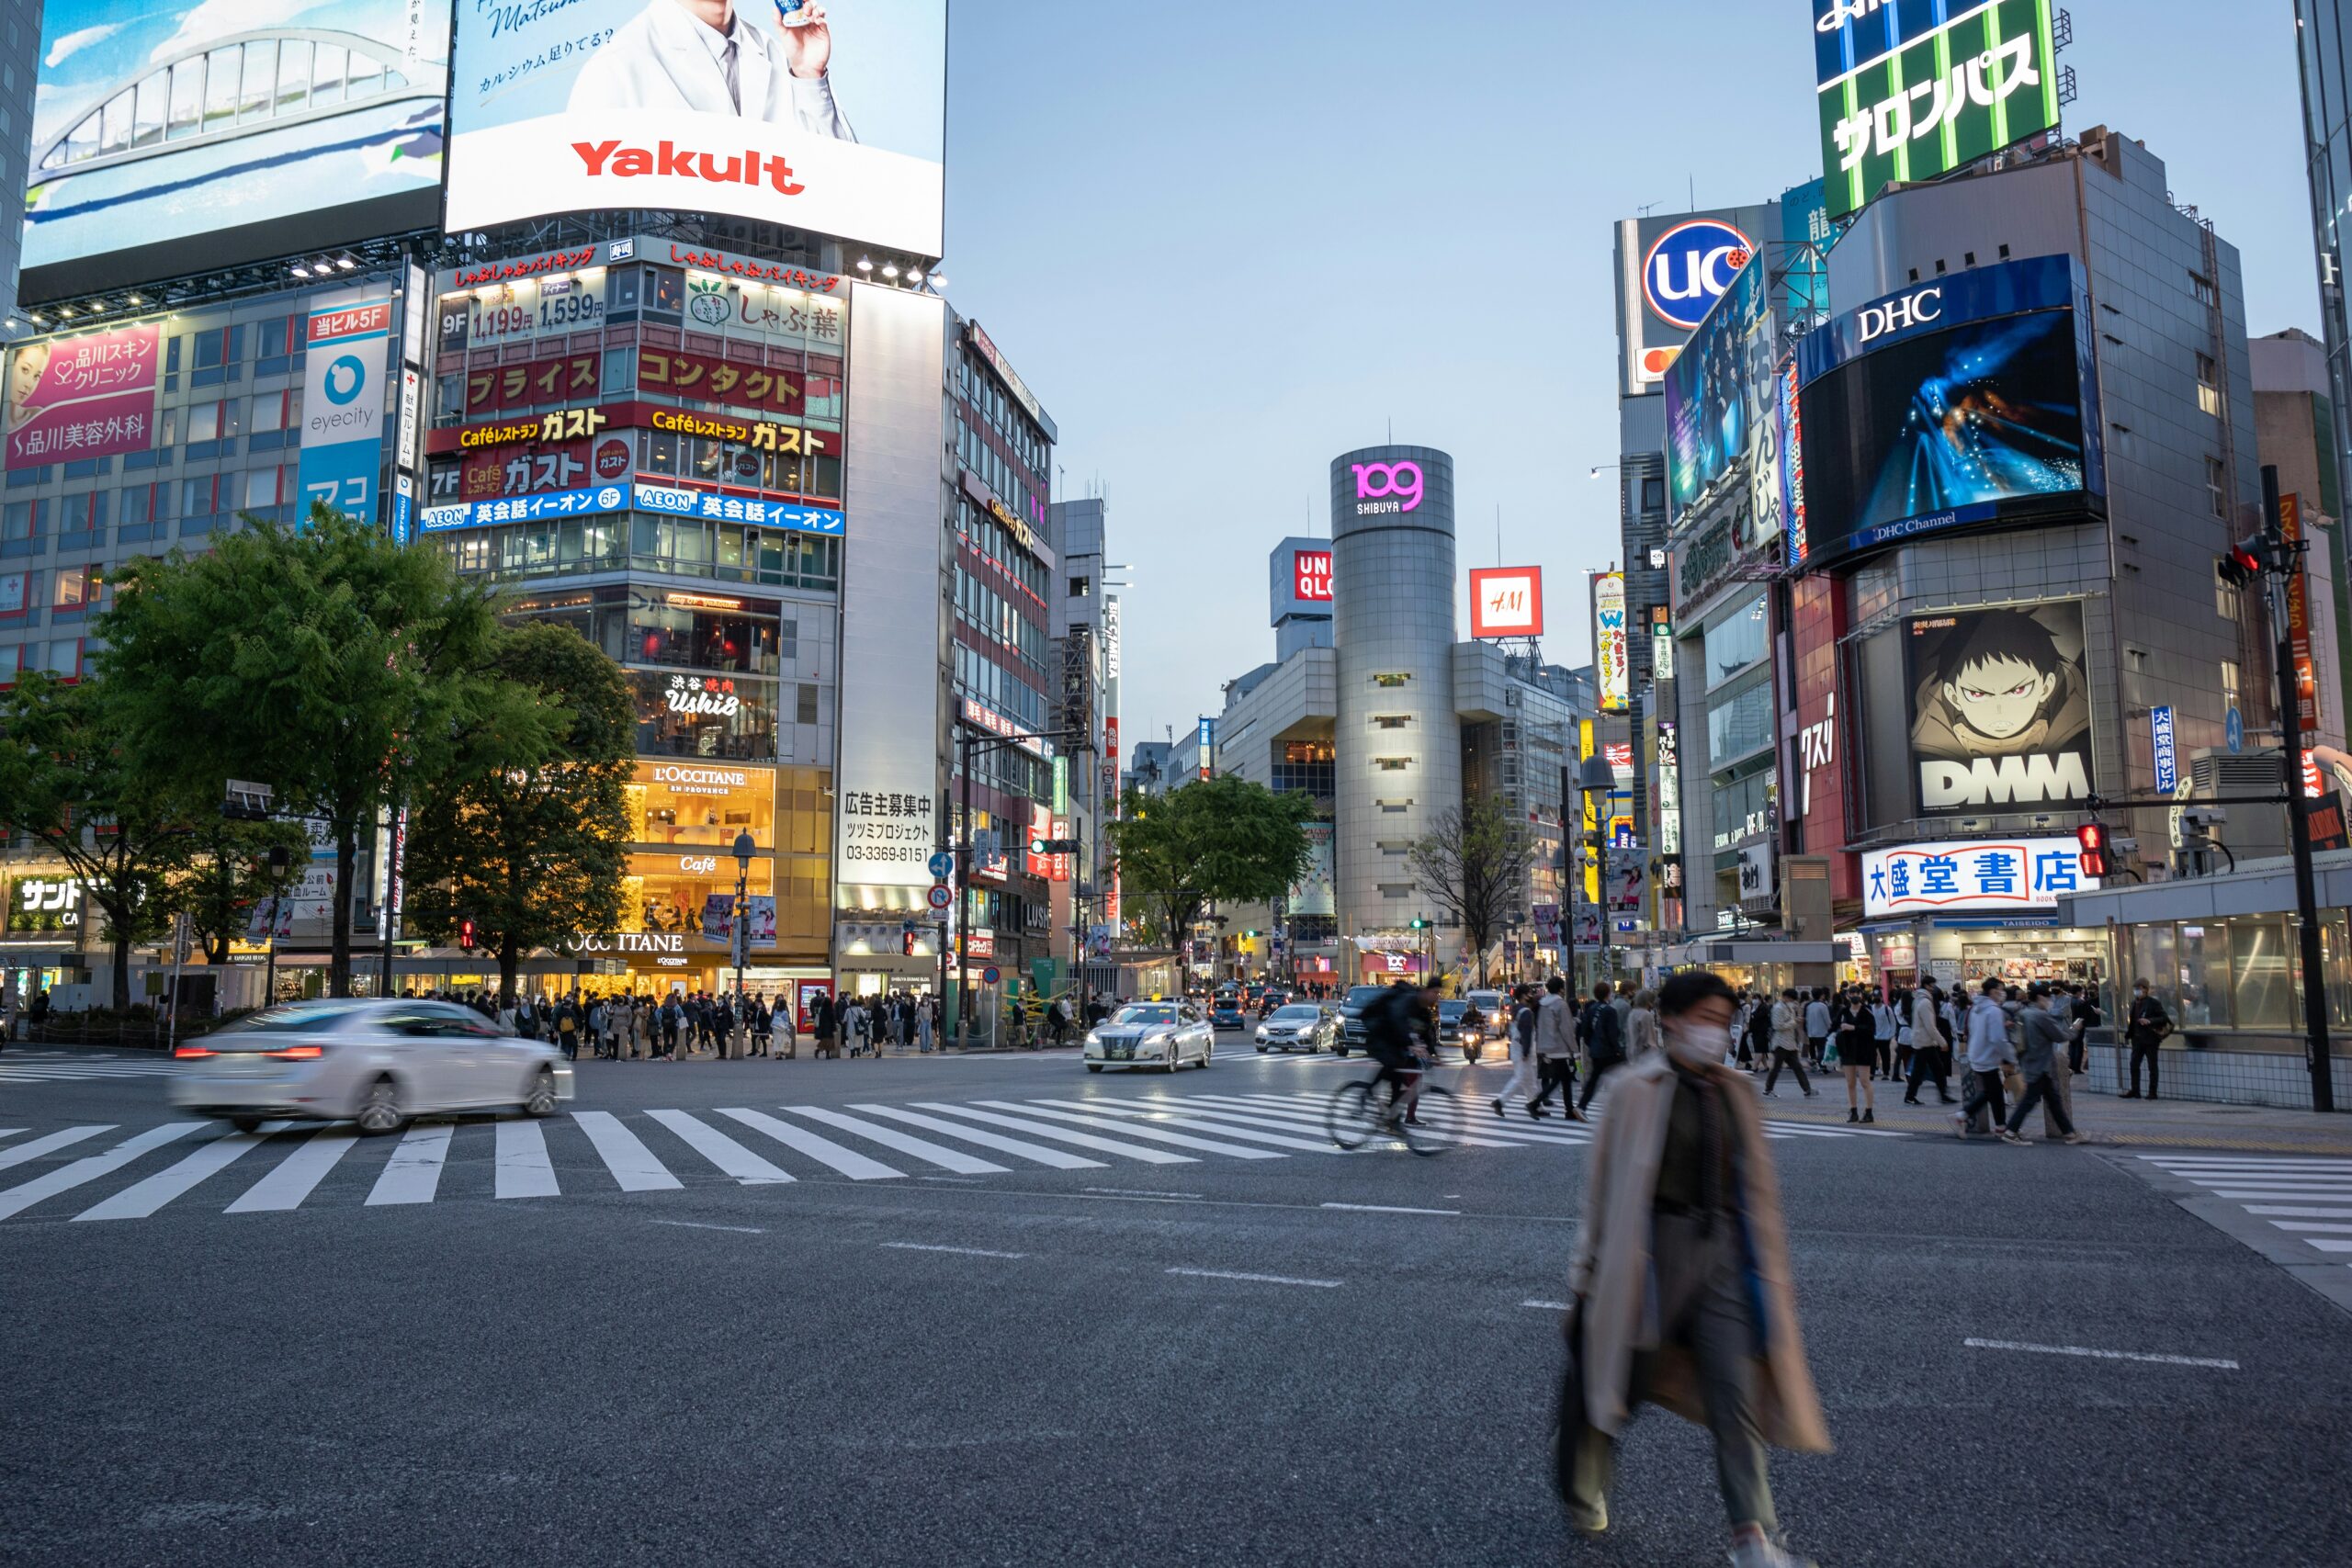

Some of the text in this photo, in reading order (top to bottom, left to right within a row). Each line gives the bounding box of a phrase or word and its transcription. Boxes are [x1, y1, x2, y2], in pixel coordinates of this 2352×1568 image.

[1833, 32, 2040, 172] サロンパス
[571, 140, 806, 196] Yakult
[454, 244, 596, 287] しゃぶしゃぶバイキング
[670, 243, 840, 292] しゃぶしゃぶバイキング
[315, 307, 382, 337] 当ビル5F
[442, 313, 467, 335] 9F
[540, 293, 604, 332] 1,599円
[741, 294, 839, 340] しゃぶ葉
[1858, 287, 1942, 343] DHC
[75, 337, 152, 368] 品川スキン
[74, 361, 141, 390] クリニック
[469, 357, 596, 405] プライス
[639, 353, 801, 404] コンタクト
[26, 412, 144, 457] 品川美容外科
[311, 409, 374, 434] eyecity
[541, 407, 606, 442] ガスト
[1748, 327, 1781, 532] もんじゃ
[752, 423, 825, 457] ガスト
[467, 464, 501, 483] Café
[503, 451, 584, 494] ガスト
[600, 458, 627, 469] ガスト
[432, 470, 460, 495] 7F
[600, 491, 618, 504] 6F
[1351, 461, 1424, 513] 109
[475, 492, 594, 526] 英会話イーオン
[641, 490, 691, 510] AEON
[701, 495, 842, 530] 英会話イーオン
[1357, 502, 1399, 515] SHIBUYA
[426, 508, 466, 528] AEON
[1876, 511, 1956, 539] DHC Channel
[1490, 591, 1523, 614] H&M
[1919, 751, 2091, 807] DMM
[844, 791, 931, 818] 広告主募集中
[847, 823, 929, 841] ツツミプロジェクト
[680, 856, 716, 874] Café
[847, 844, 928, 863] 03-3369-8151
[1870, 851, 2078, 902] 大盛堂書店
[1026, 903, 1049, 930] LUSH
